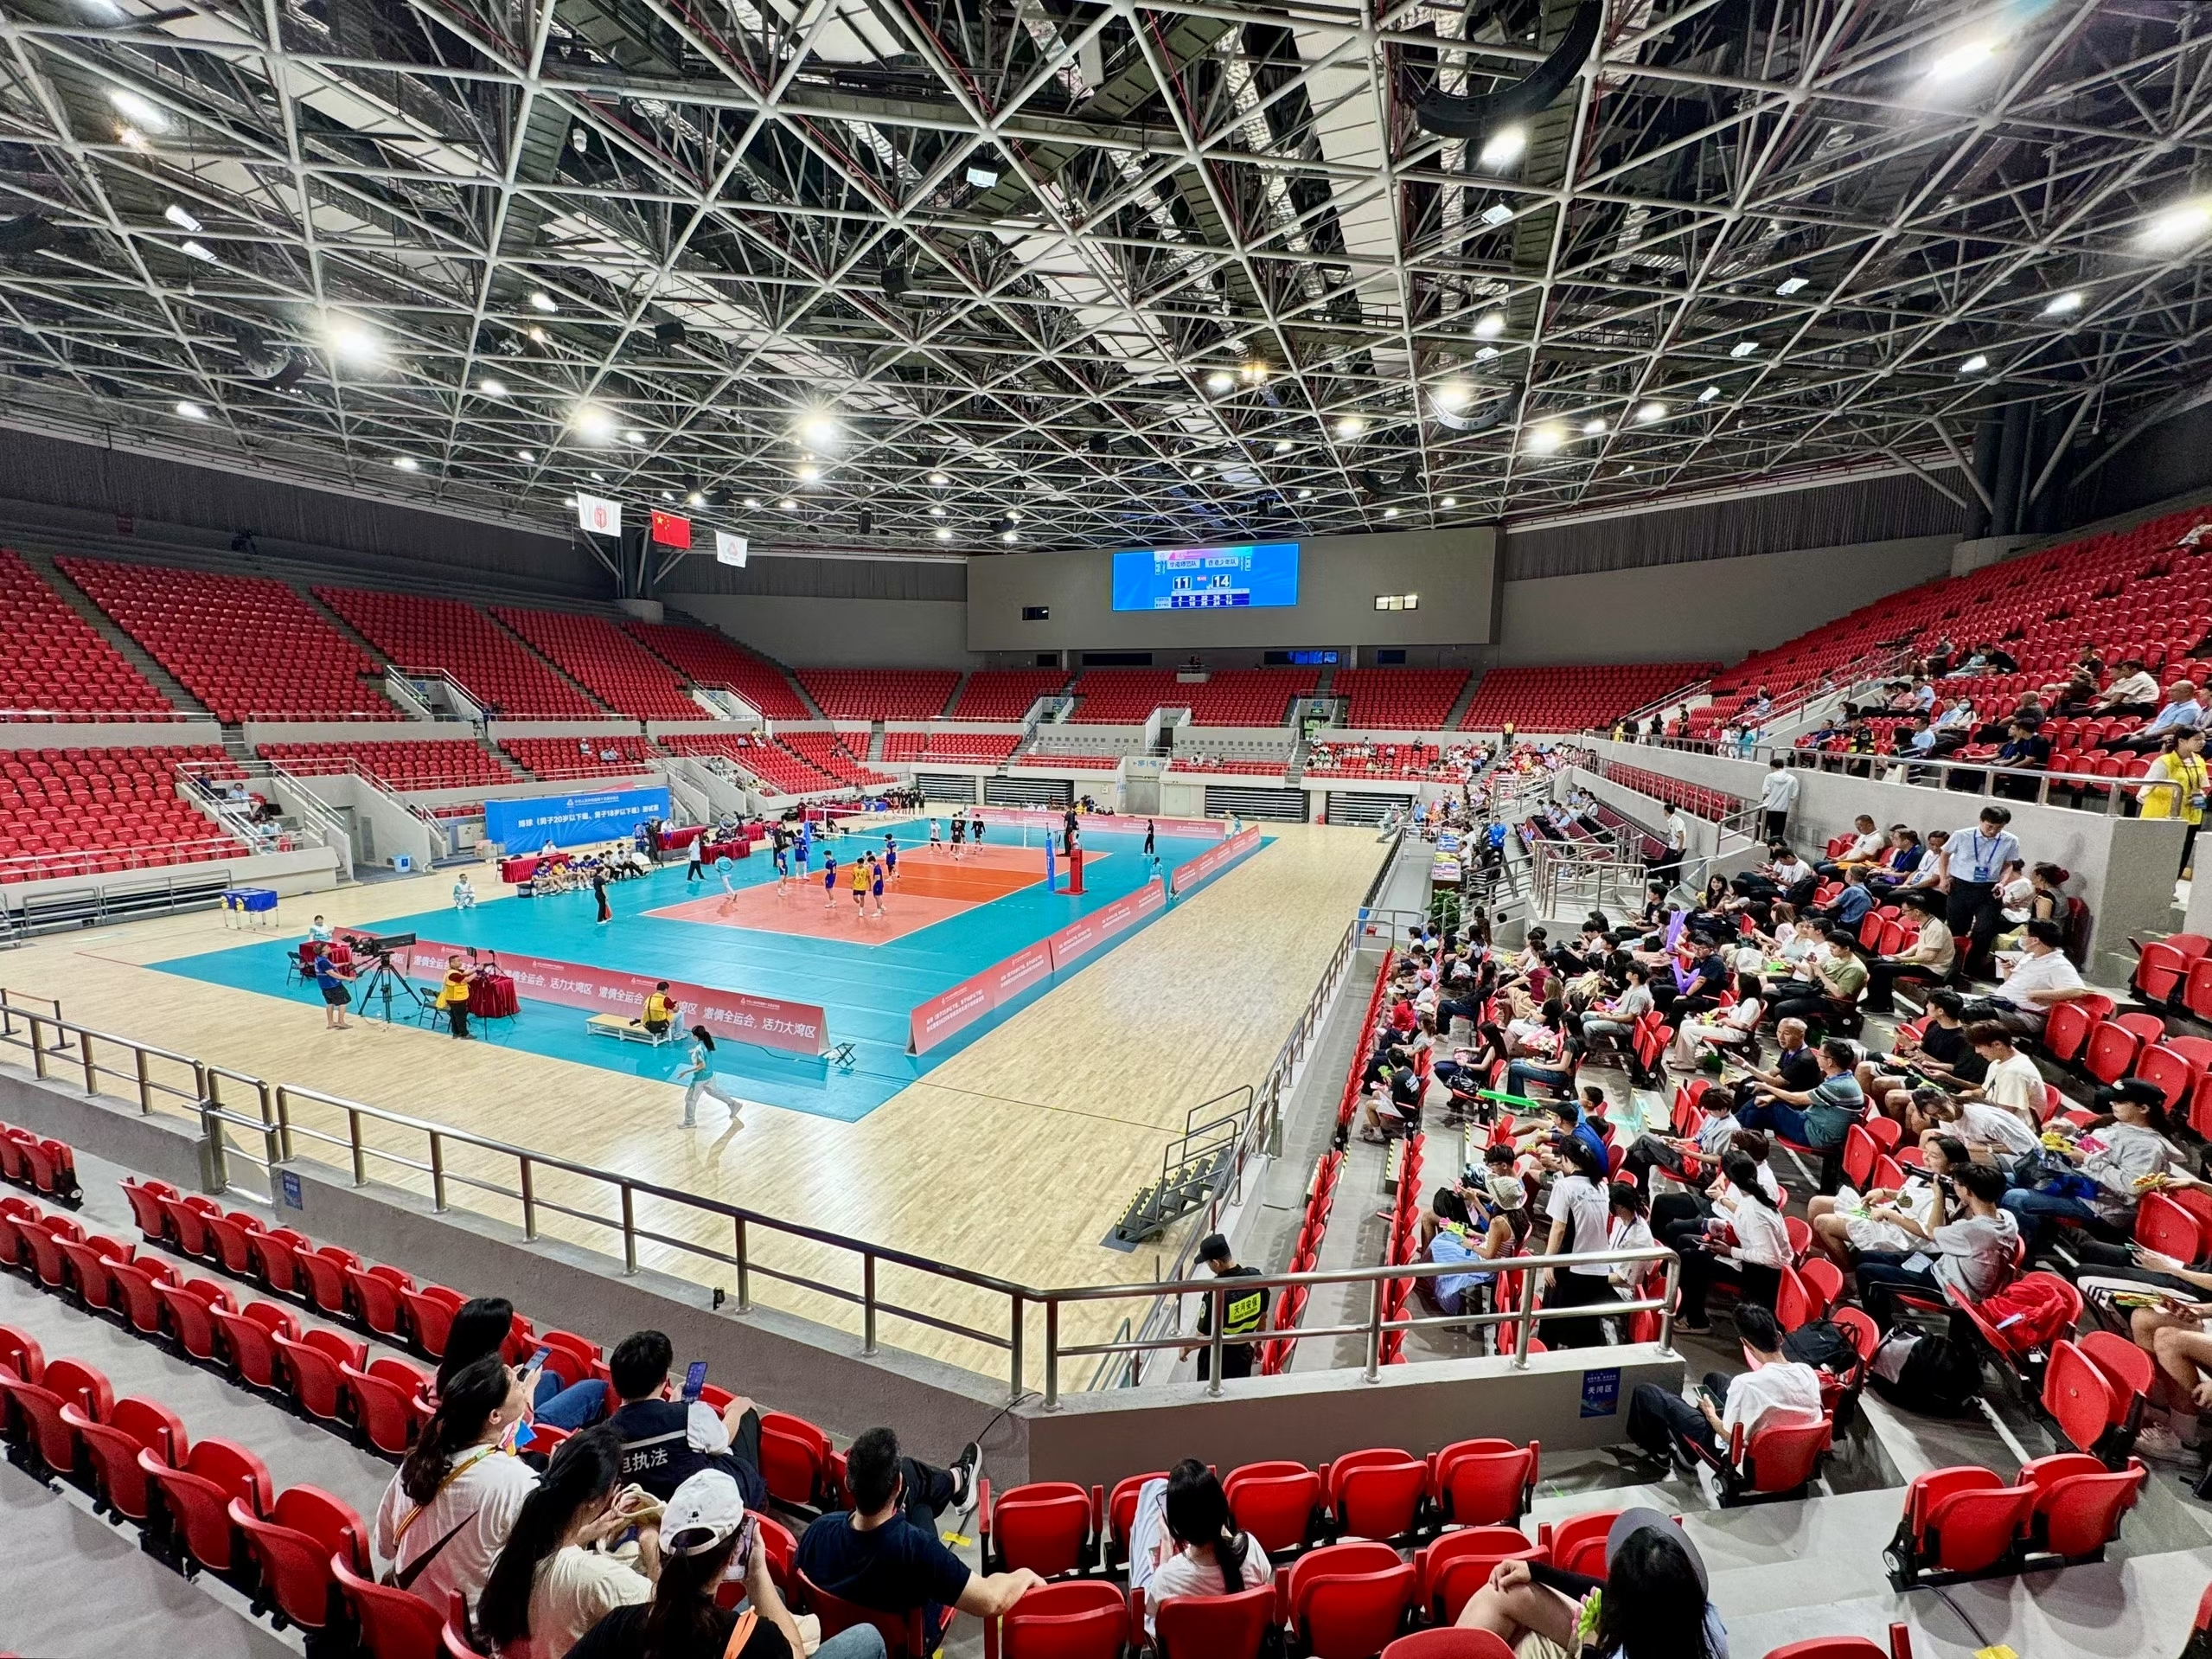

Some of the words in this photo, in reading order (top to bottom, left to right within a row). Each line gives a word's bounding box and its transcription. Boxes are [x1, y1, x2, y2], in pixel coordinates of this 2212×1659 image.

[1175, 577, 1189, 589] 11
[1214, 575, 1229, 587] 14
[1588, 1385, 1613, 1394] 天河区
[1889, 1556, 1894, 1566] 6
